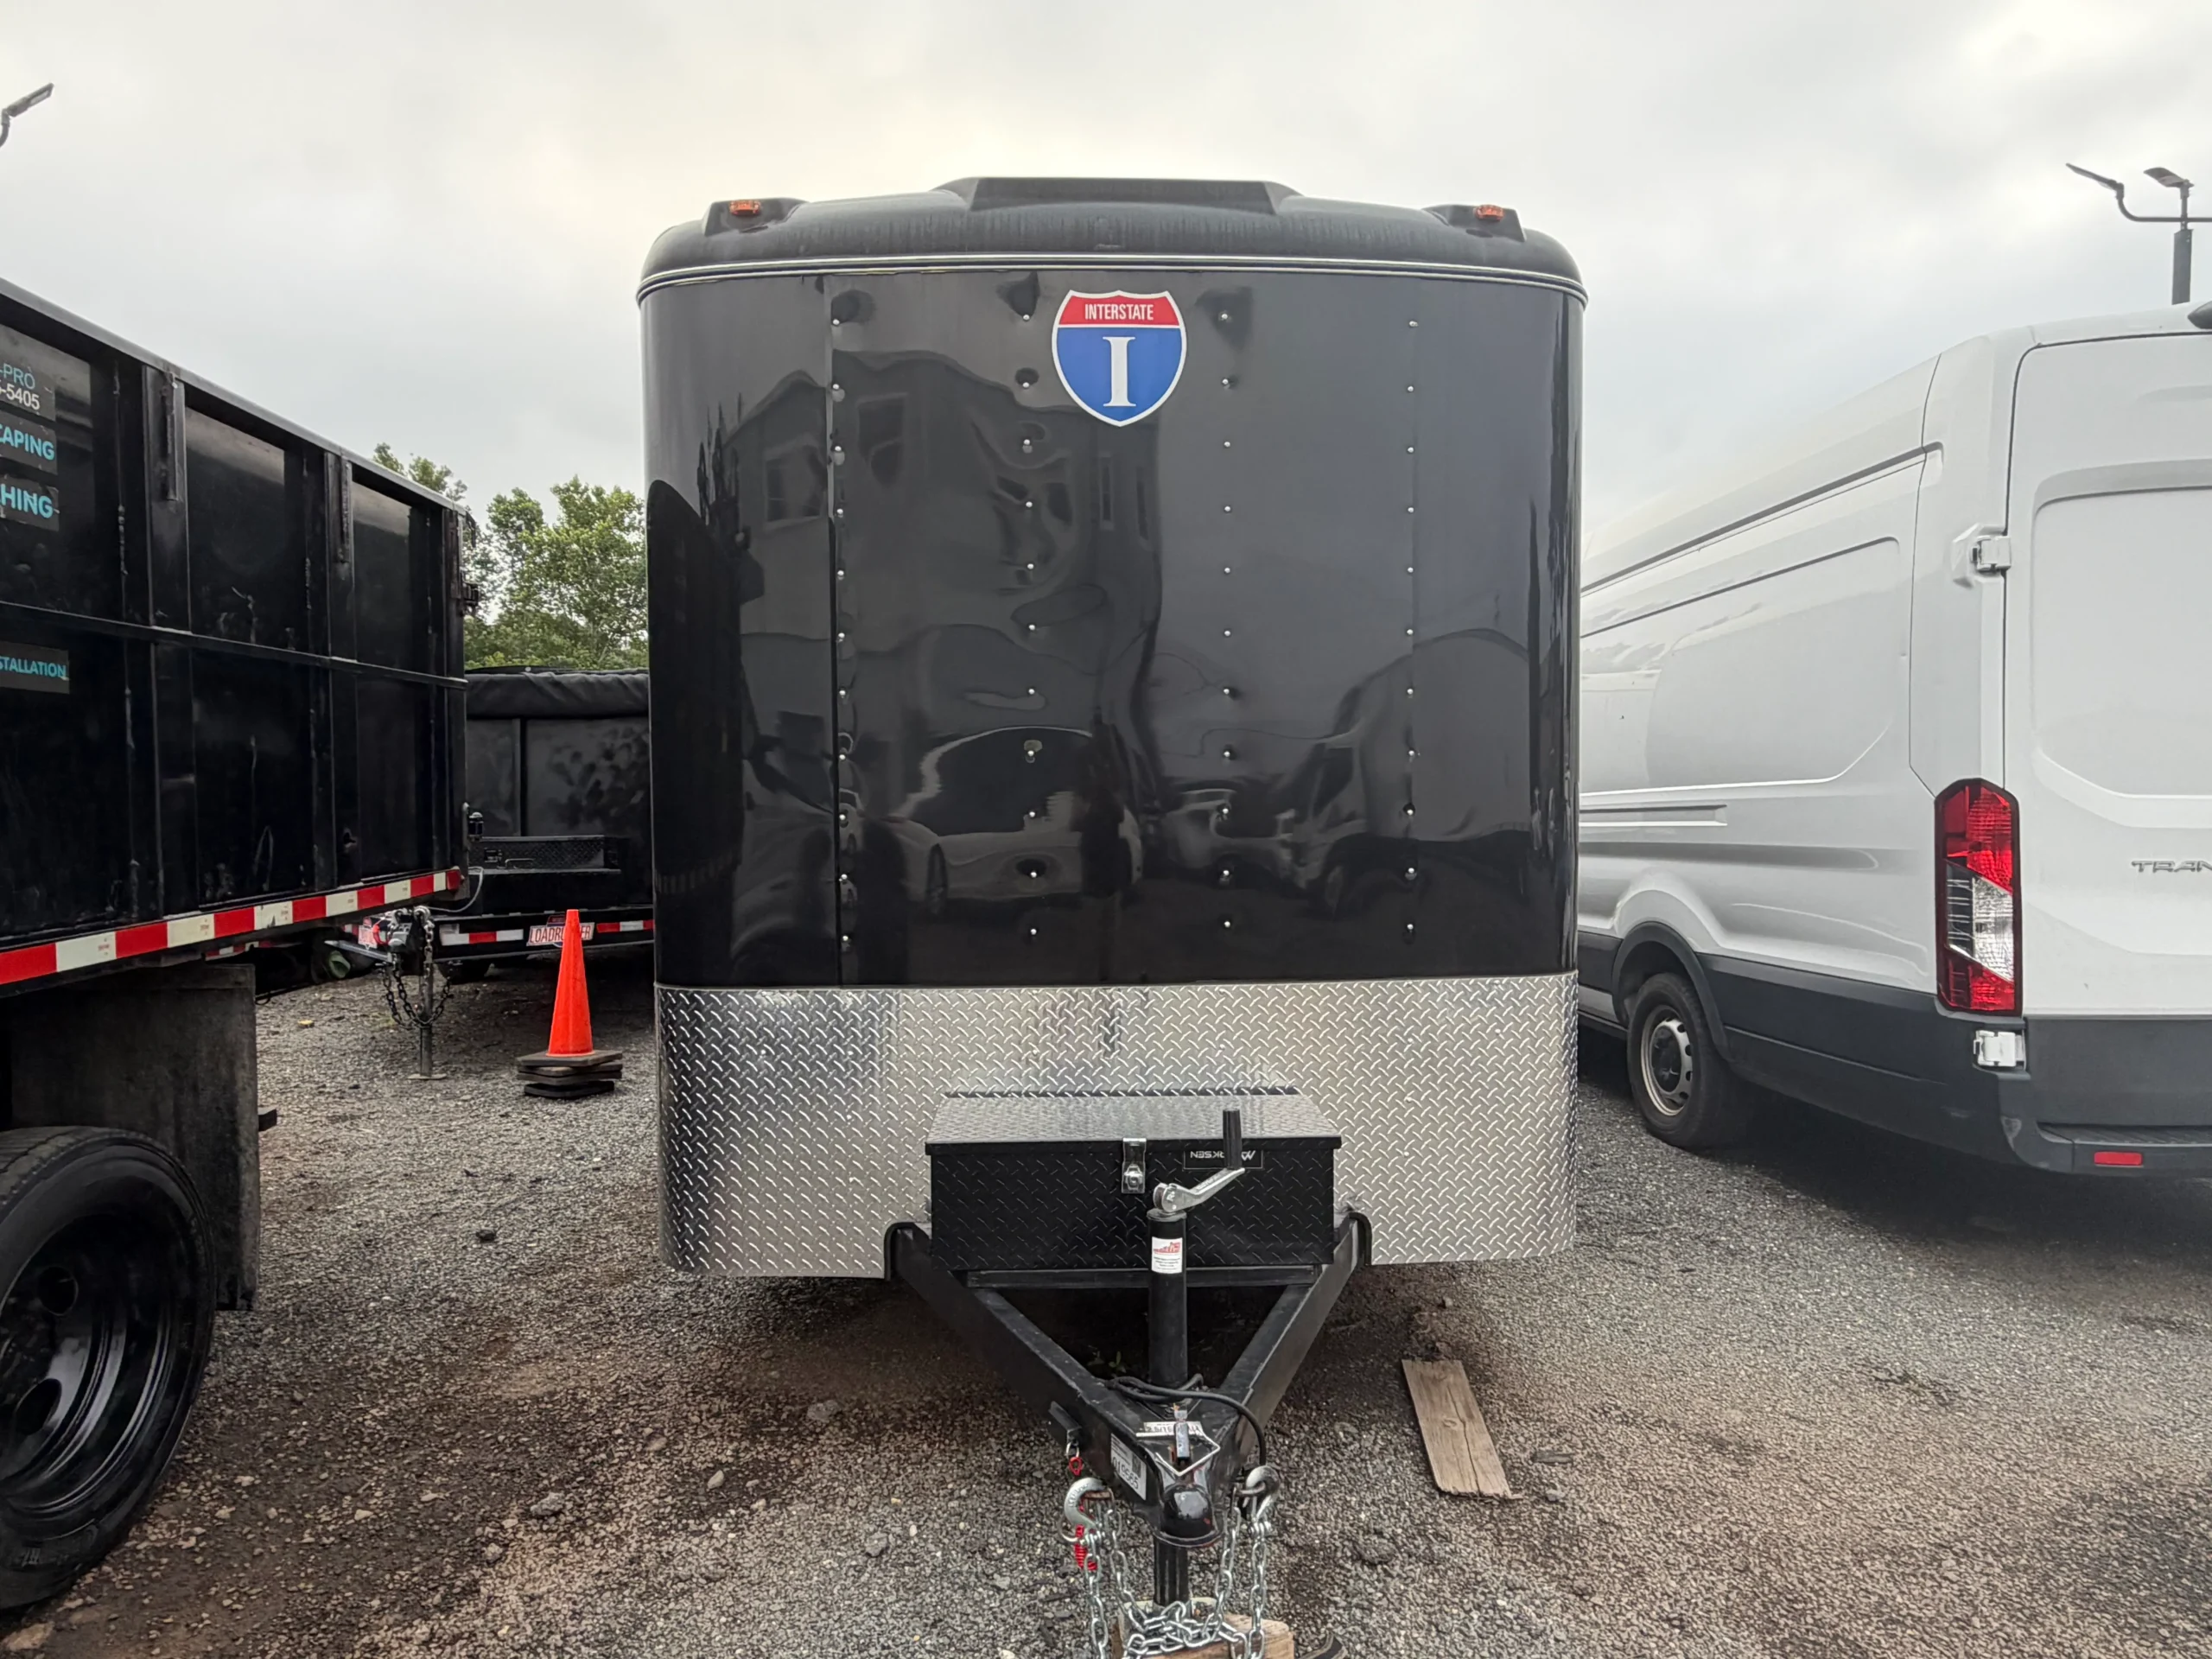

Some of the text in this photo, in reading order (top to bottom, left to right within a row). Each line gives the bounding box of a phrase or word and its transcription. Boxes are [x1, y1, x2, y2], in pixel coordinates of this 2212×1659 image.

[1085, 304, 1154, 321] INTERSTATE
[1102, 336, 1136, 407] I
[0, 383, 41, 410] -5405
[0, 424, 55, 461] APING
[530, 925, 591, 944] LOADRER
